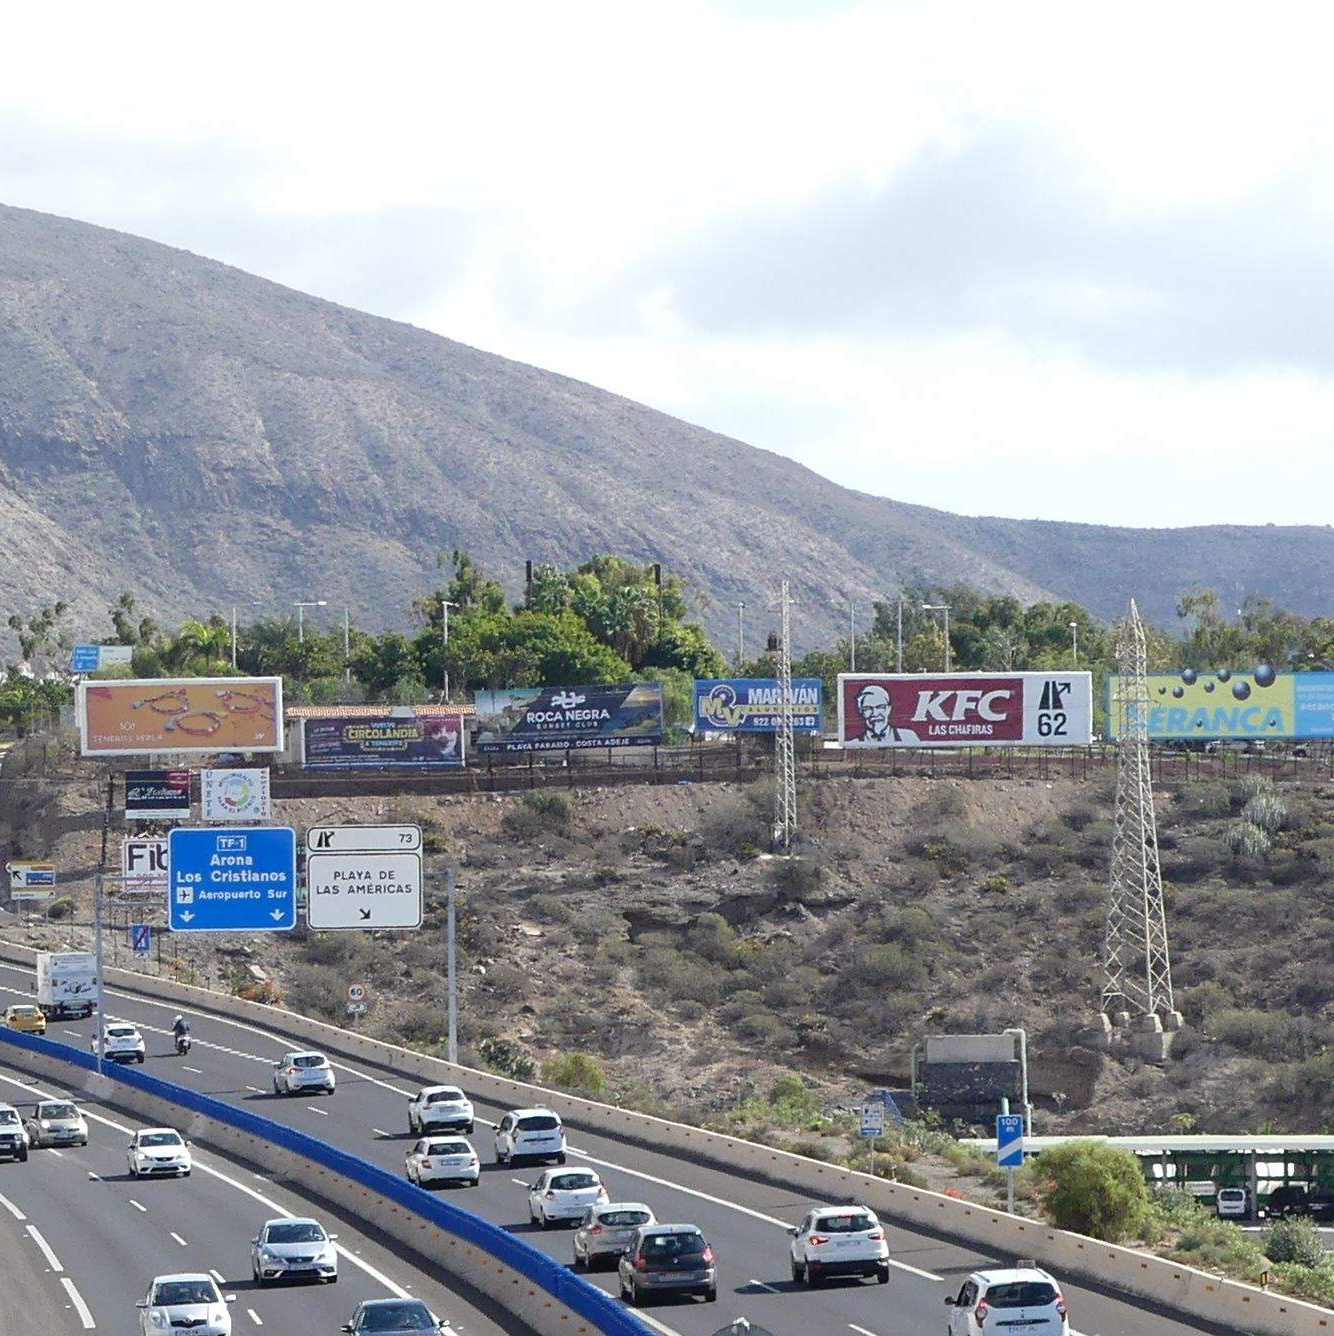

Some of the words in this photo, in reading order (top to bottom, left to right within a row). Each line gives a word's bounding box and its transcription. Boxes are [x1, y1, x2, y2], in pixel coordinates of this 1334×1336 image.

[748, 683, 818, 704] MARVÁN
[911, 690, 1011, 721] KFC
[527, 711, 563, 723] ROCA
[566, 709, 610, 721] NEGRA
[928, 725, 947, 735] LAS
[1038, 713, 1067, 736] 62
[348, 728, 419, 739] CIRCOLANDIA
[220, 838, 245, 848] TF-1
[399, 834, 413, 843] 73
[209, 853, 254, 866] Arona
[177, 870, 202, 883] Los
[211, 870, 287, 882] Cristianos
[333, 870, 372, 880] PLAYA
[379, 870, 395, 880] DE
[199, 889, 261, 901] Aeropuerto
[267, 889, 288, 899] Sur
[316, 885, 340, 895] LAS
[347, 883, 413, 894] AMÉRICAS
[1000, 1118, 1018, 1126] 100
